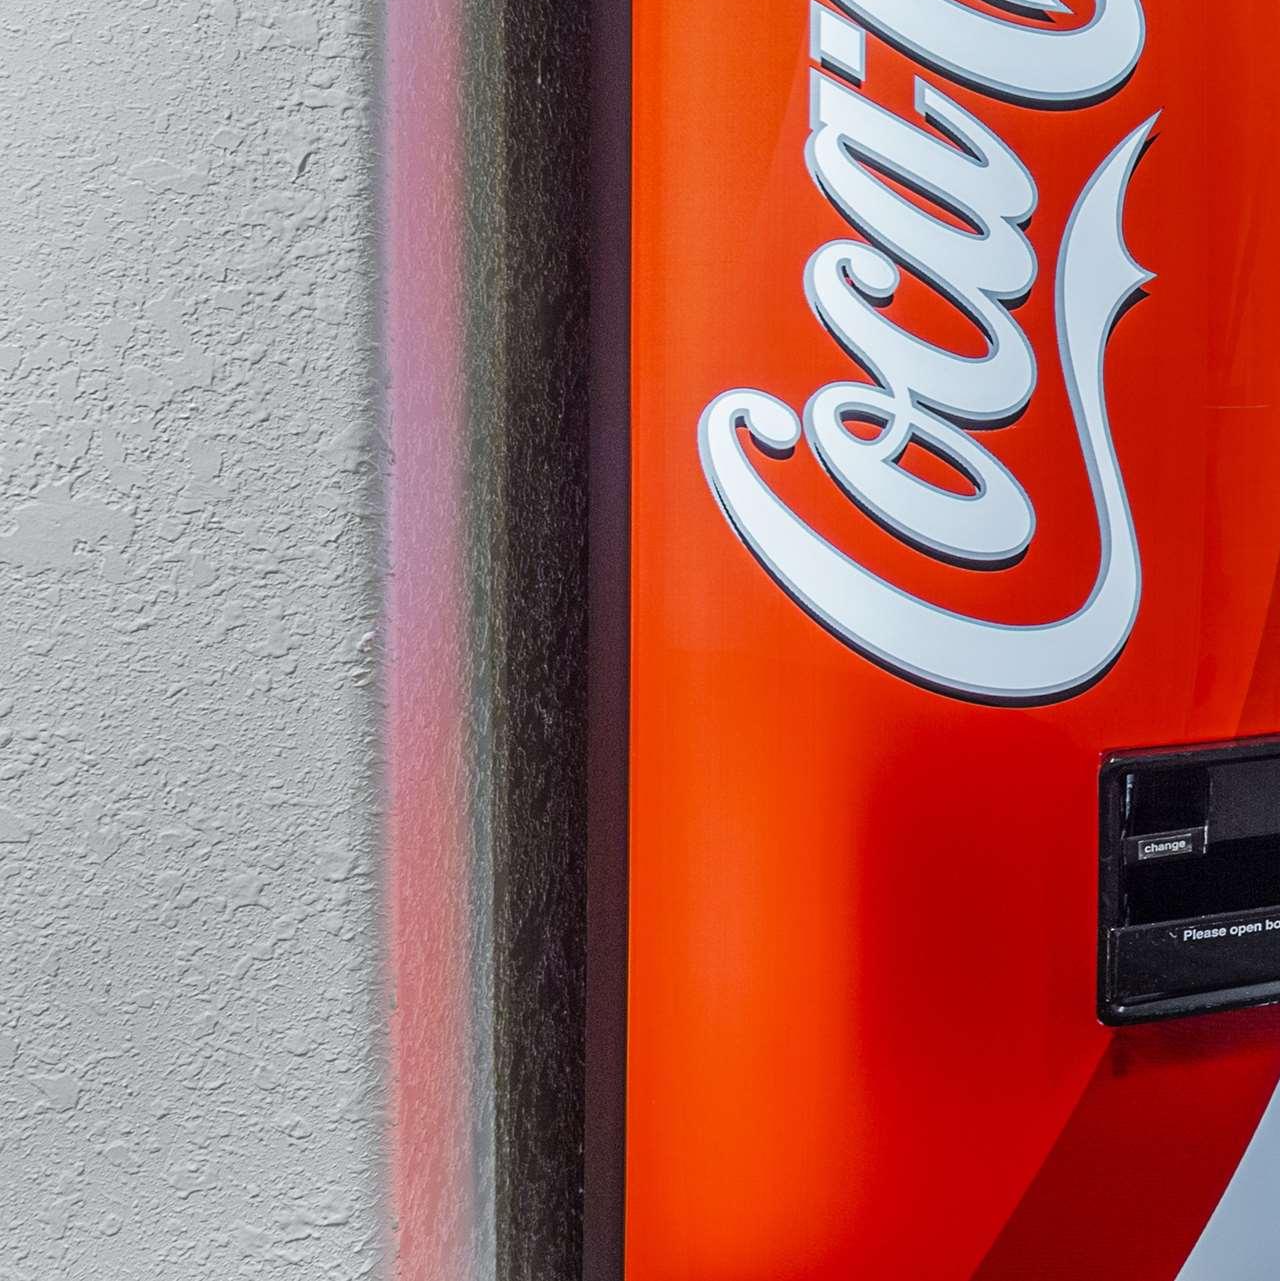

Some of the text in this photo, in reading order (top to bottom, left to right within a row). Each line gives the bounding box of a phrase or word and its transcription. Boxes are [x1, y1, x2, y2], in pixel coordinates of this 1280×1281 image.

[1144, 839, 1187, 854] change
[1183, 926, 1227, 942] Please
[1229, 922, 1262, 938] open
